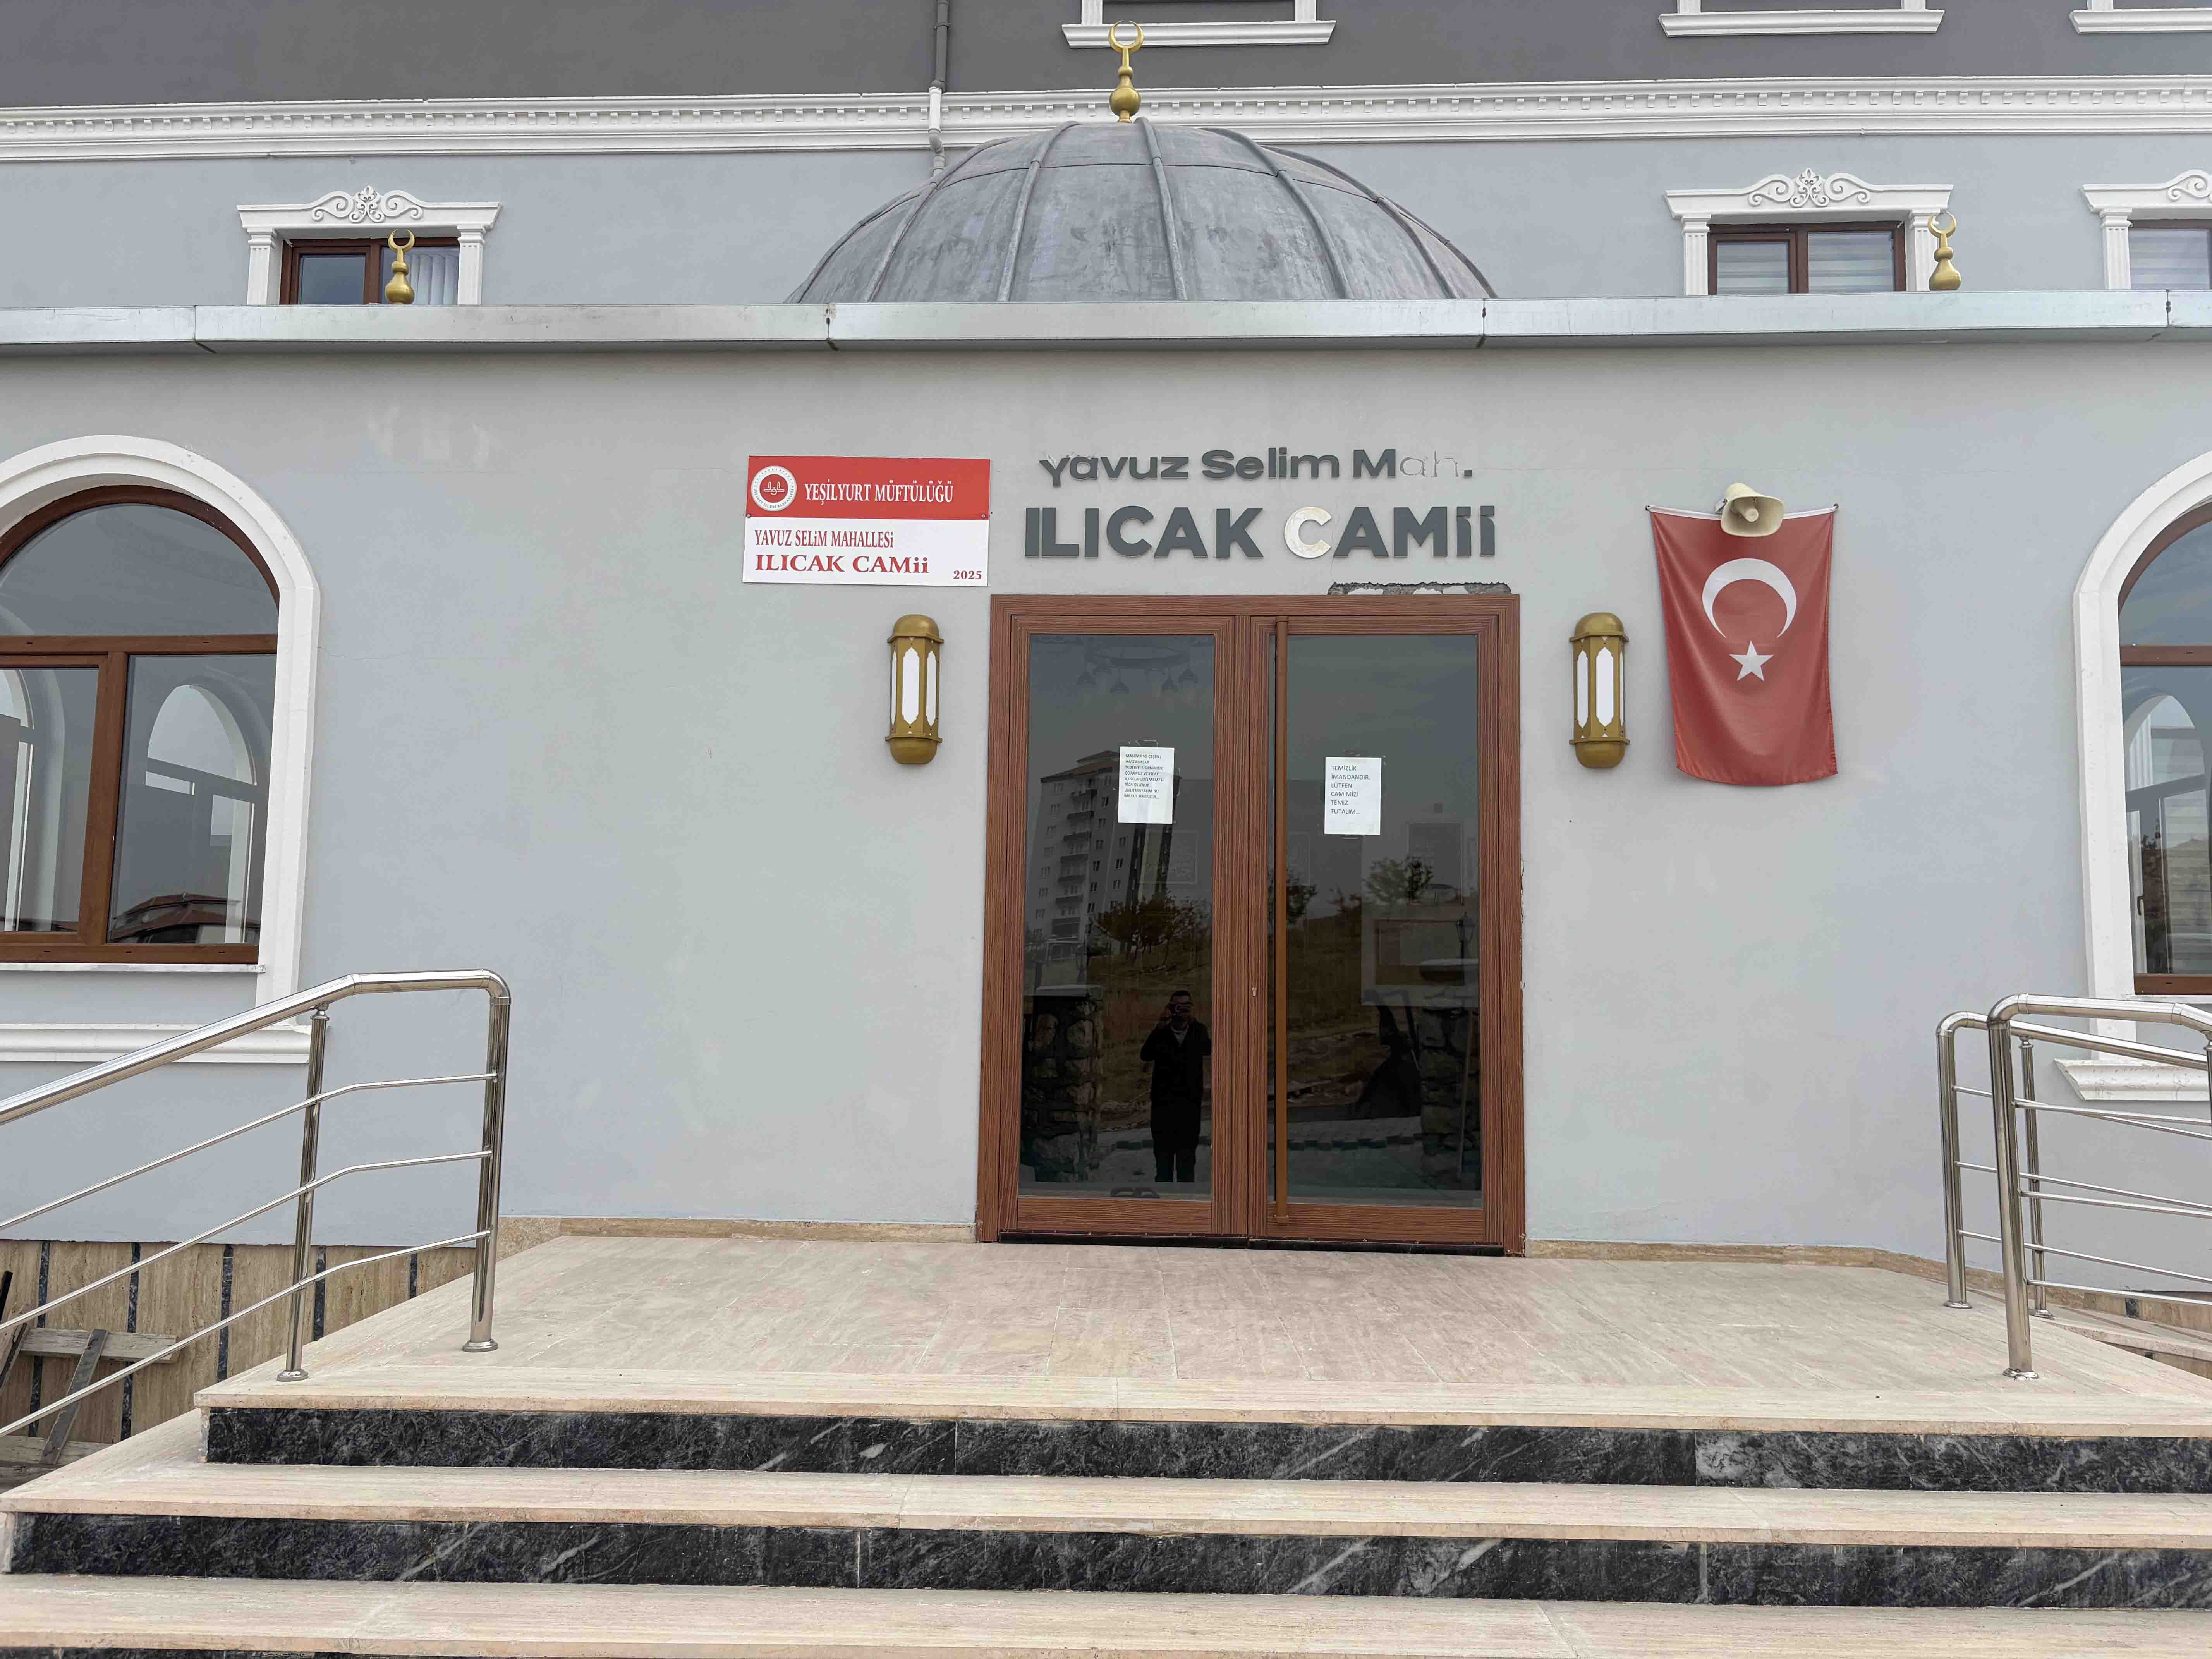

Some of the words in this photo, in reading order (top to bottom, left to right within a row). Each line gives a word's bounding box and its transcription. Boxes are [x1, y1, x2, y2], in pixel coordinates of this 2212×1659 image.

[1039, 455, 1189, 487] Yavuz
[1202, 447, 1340, 479] Selim
[805, 479, 871, 505] YEŞİLYURT
[874, 480, 954, 503] MÜFTÜLÜĞÜ
[755, 529, 793, 546] YAVUZ
[1025, 505, 1264, 558] ILICAK
[755, 554, 845, 573] ILICAK
[953, 570, 982, 580] 2025
